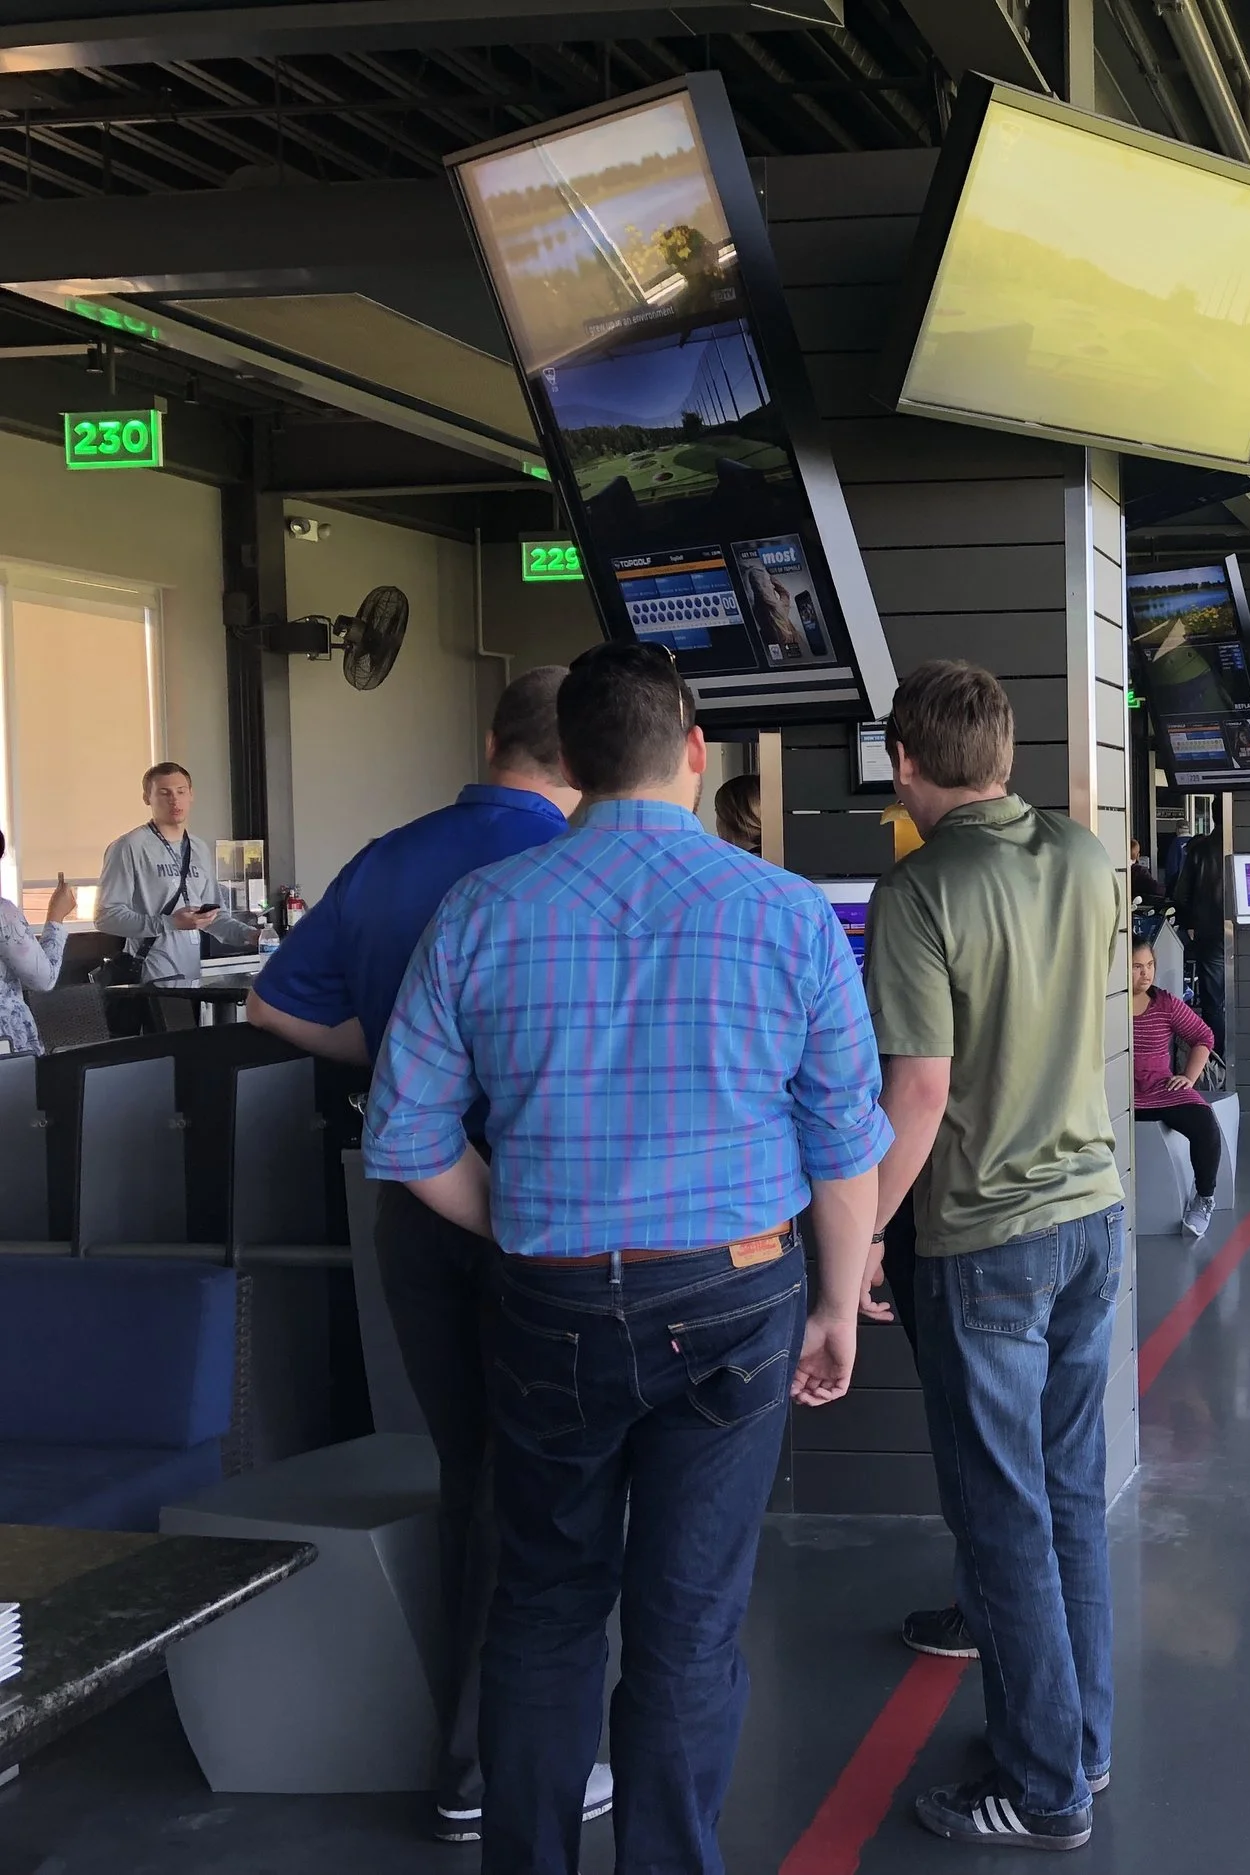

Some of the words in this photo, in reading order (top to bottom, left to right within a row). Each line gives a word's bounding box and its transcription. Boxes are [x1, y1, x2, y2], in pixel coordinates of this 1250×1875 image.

[622, 316, 632, 326] an
[633, 306, 675, 324] environment
[74, 420, 148, 454] 230
[531, 547, 579, 571] 229
[620, 557, 651, 568] TOPGOLF
[762, 547, 796, 564] most
[157, 864, 199, 878] MUSG
